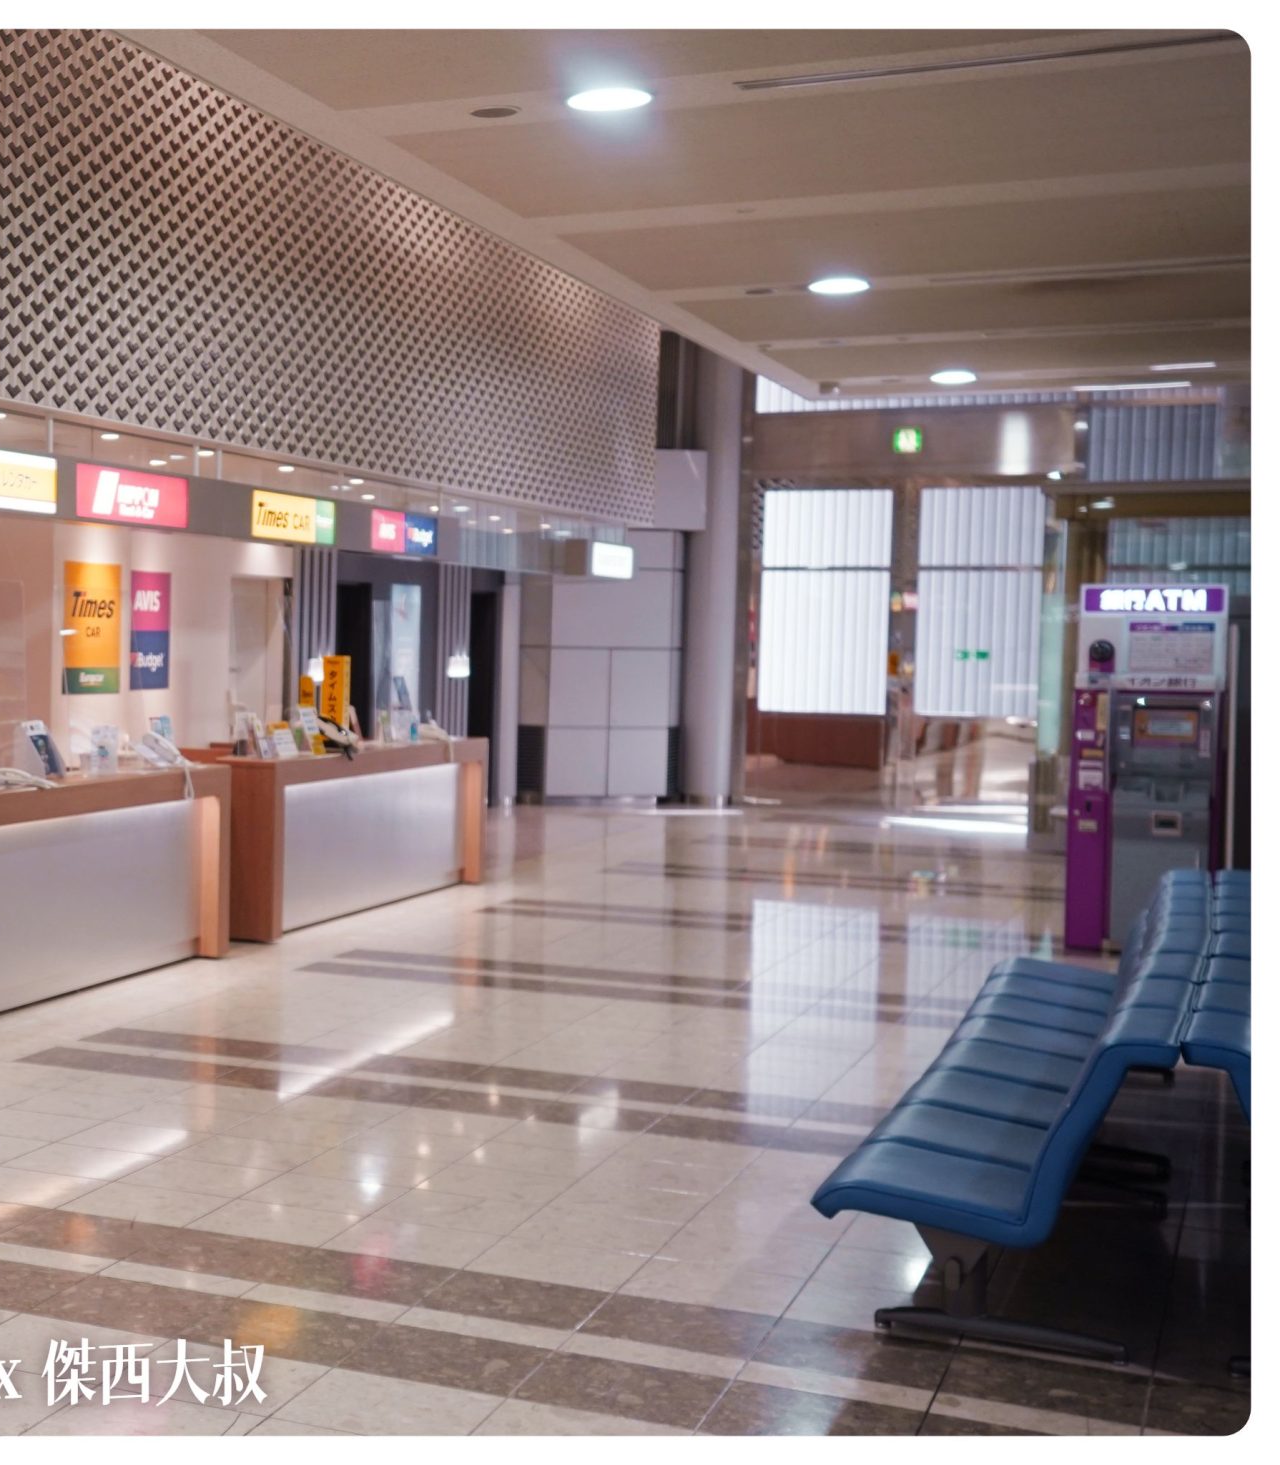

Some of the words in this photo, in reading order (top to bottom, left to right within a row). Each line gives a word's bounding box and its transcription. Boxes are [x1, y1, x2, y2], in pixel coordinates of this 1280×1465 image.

[256, 502, 289, 528] Times
[292, 514, 310, 530] CAR
[72, 591, 116, 618] Times
[134, 590, 161, 612] AVIS
[86, 626, 101, 638] CAR
[137, 652, 164, 673] Budget
